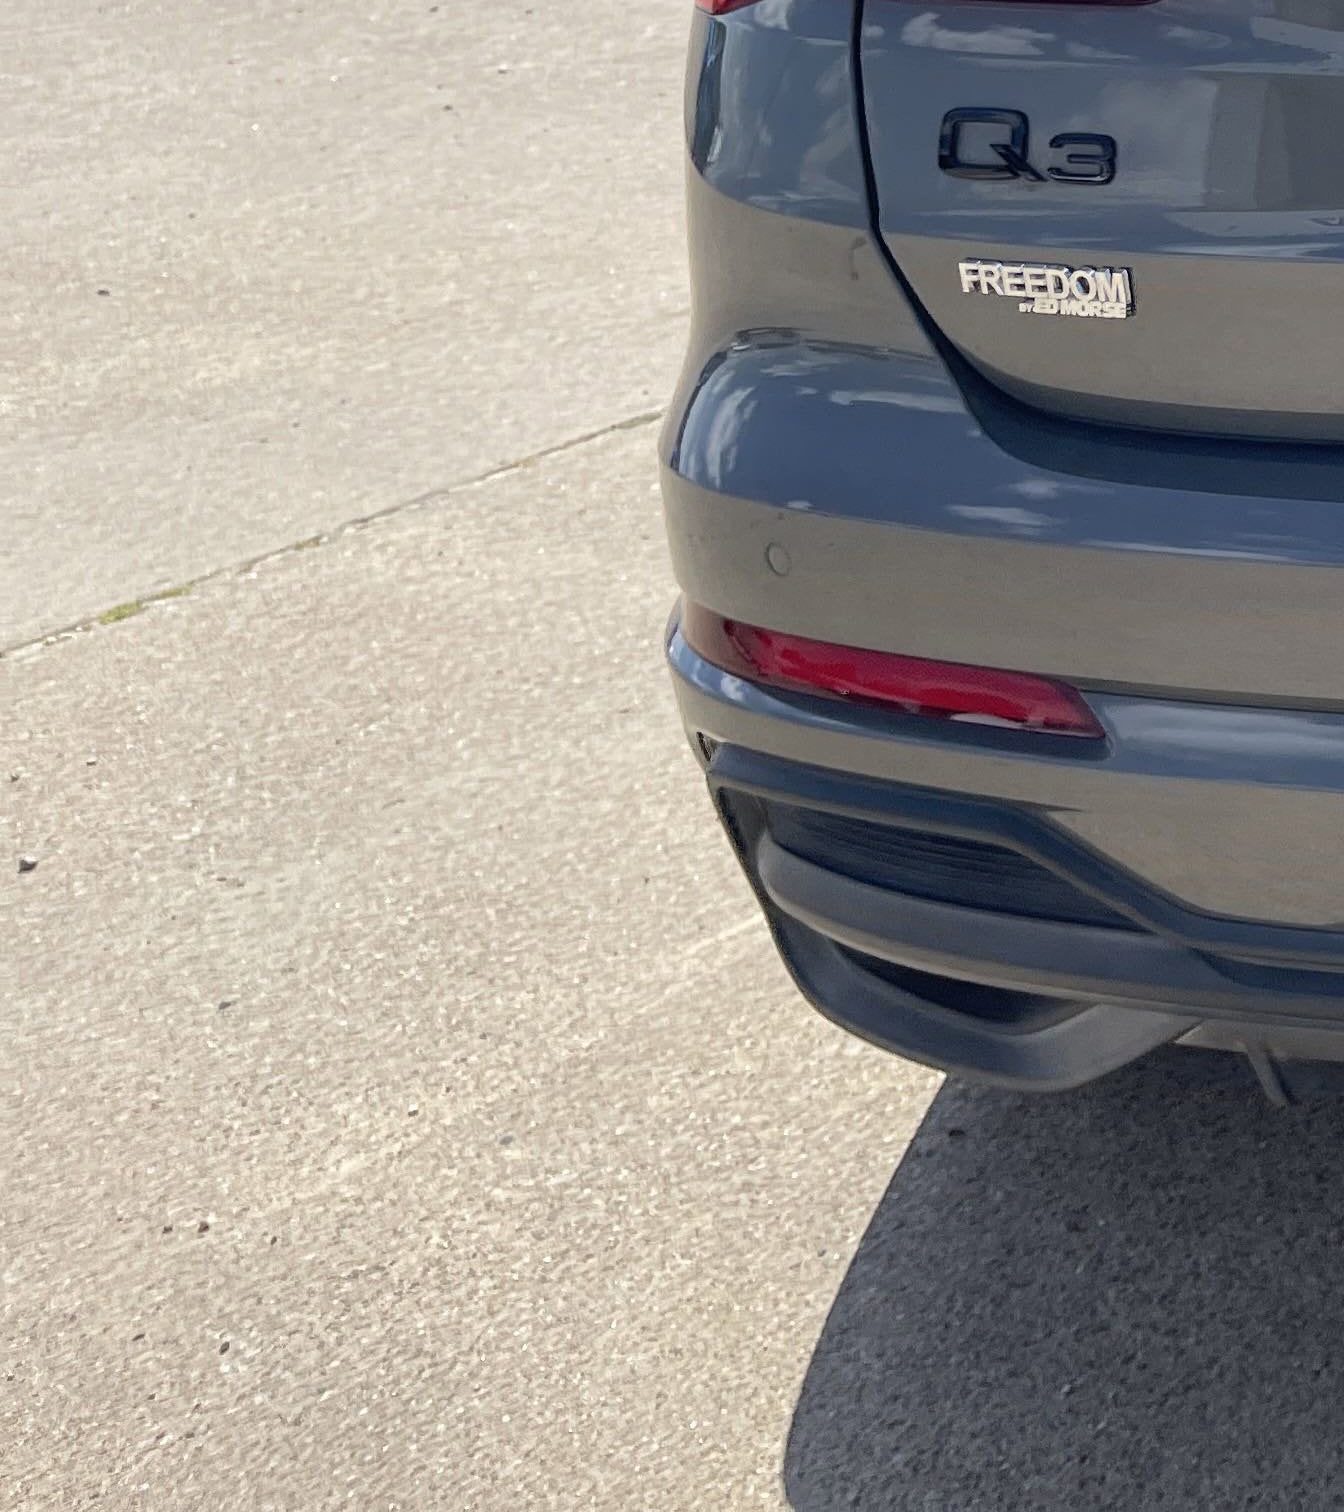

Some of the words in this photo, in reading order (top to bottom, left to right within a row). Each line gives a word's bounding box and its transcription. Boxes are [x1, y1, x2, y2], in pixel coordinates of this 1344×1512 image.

[938, 106, 1118, 186] Q3
[958, 258, 1131, 304] FREEDOM
[1060, 299, 1128, 319] MORSE
